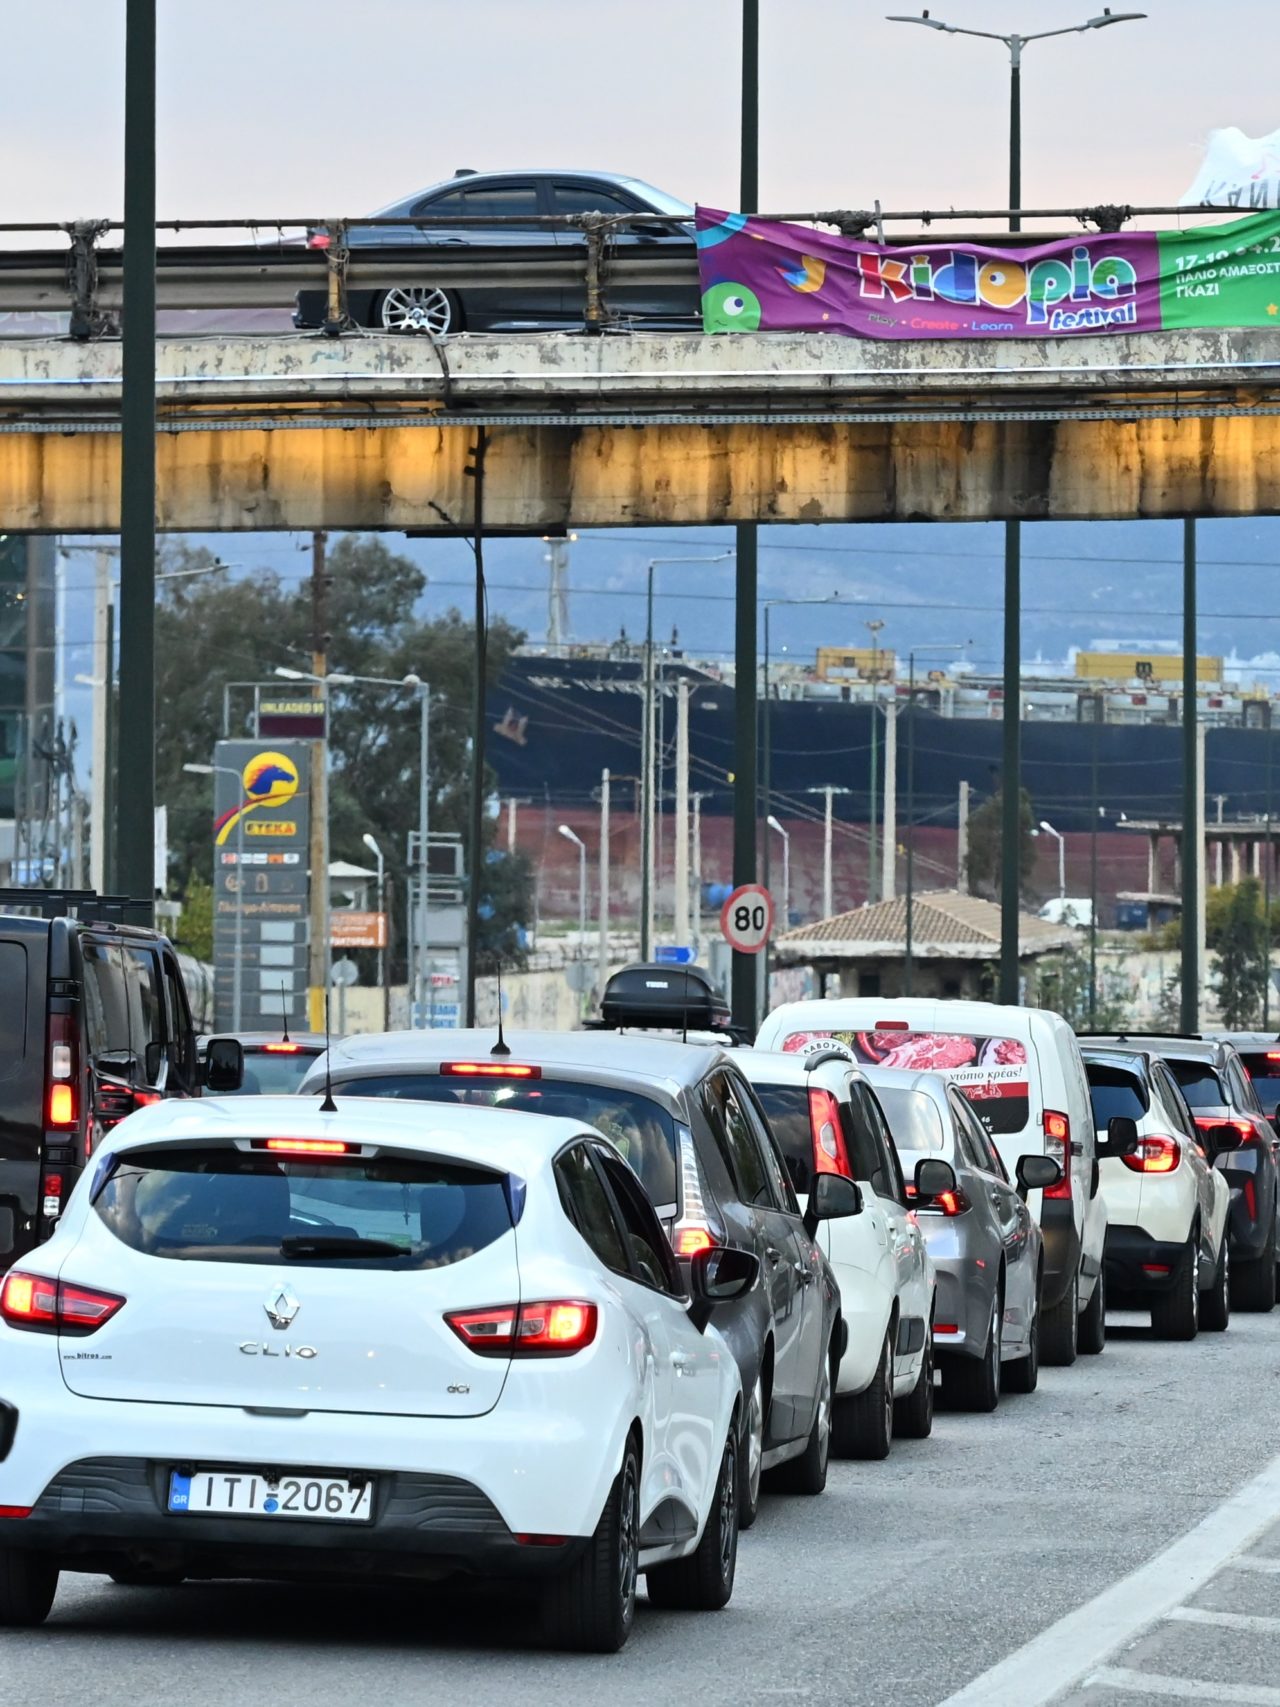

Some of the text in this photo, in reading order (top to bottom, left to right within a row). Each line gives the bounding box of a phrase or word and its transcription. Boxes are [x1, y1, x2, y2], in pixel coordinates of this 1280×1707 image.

[1176, 283, 1220, 298] ΓΚΑΖΙ
[1050, 302, 1138, 330] festival
[911, 318, 959, 330] Create
[971, 320, 1014, 331] Learn
[735, 906, 765, 931] 80
[239, 1341, 318, 1359] CLIO
[173, 1495, 187, 1504] GR
